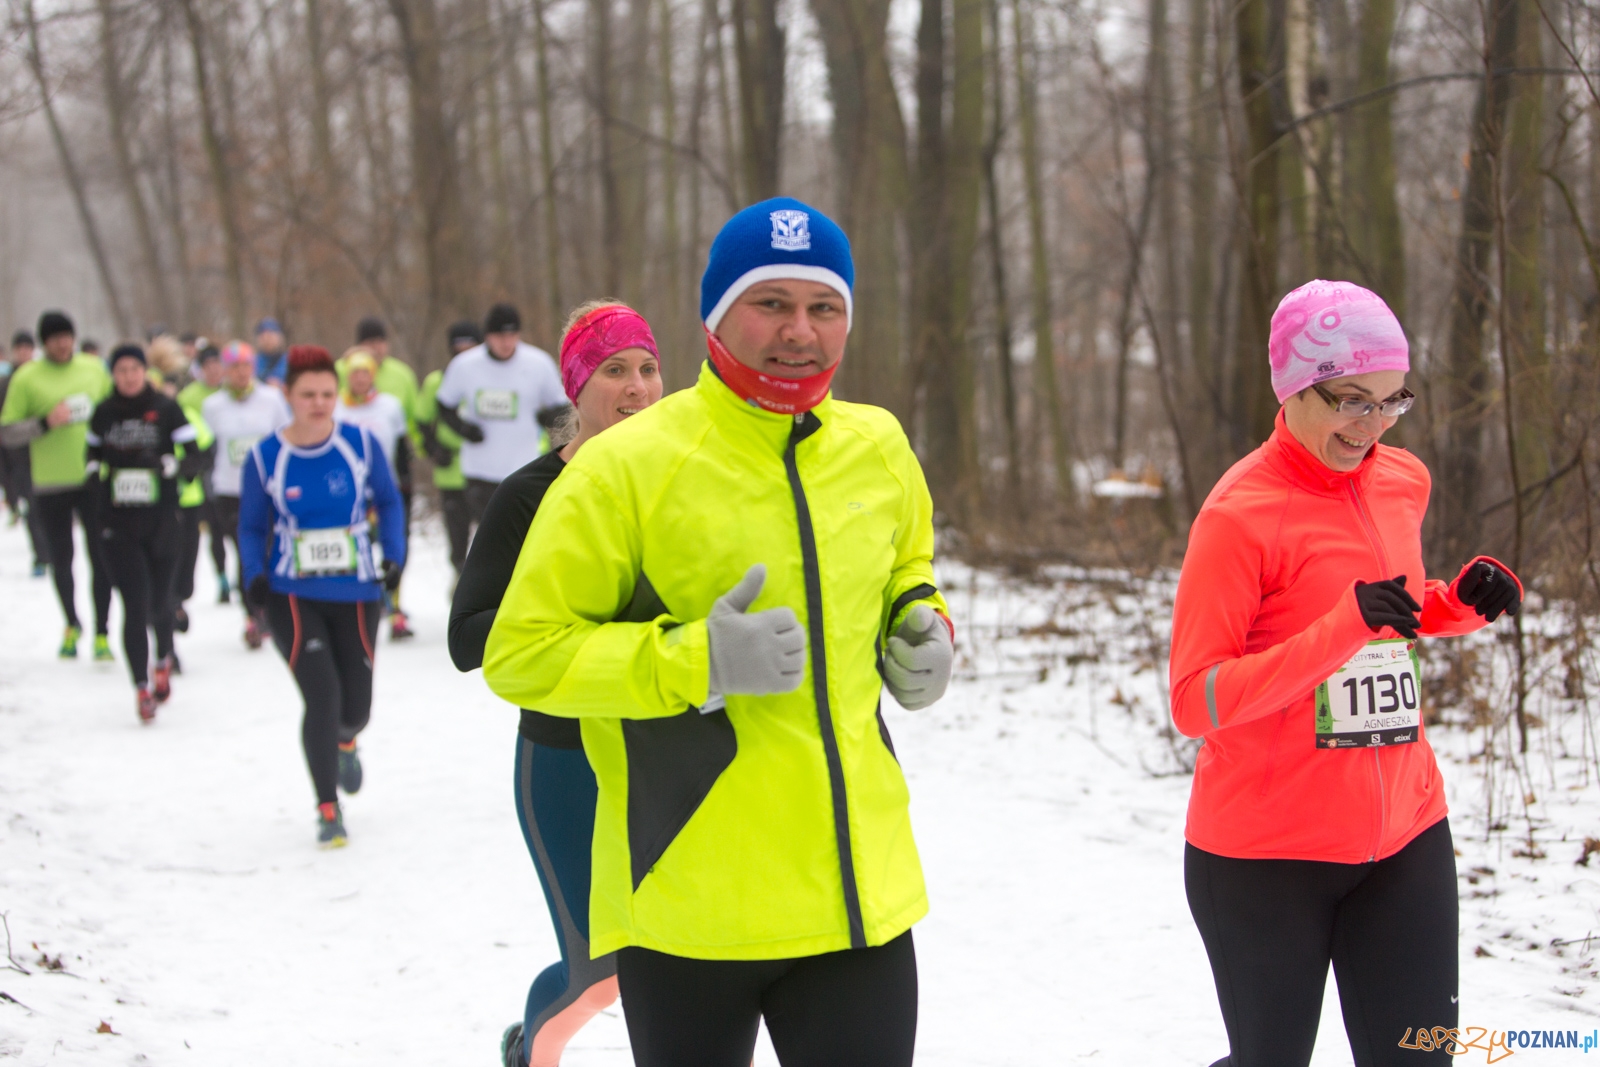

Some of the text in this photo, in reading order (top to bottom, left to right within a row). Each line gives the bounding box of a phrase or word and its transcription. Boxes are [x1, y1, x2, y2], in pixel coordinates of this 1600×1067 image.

[309, 543, 342, 561] 189
[1342, 671, 1417, 716] 1130
[1363, 716, 1412, 729] AGNIESZKA
